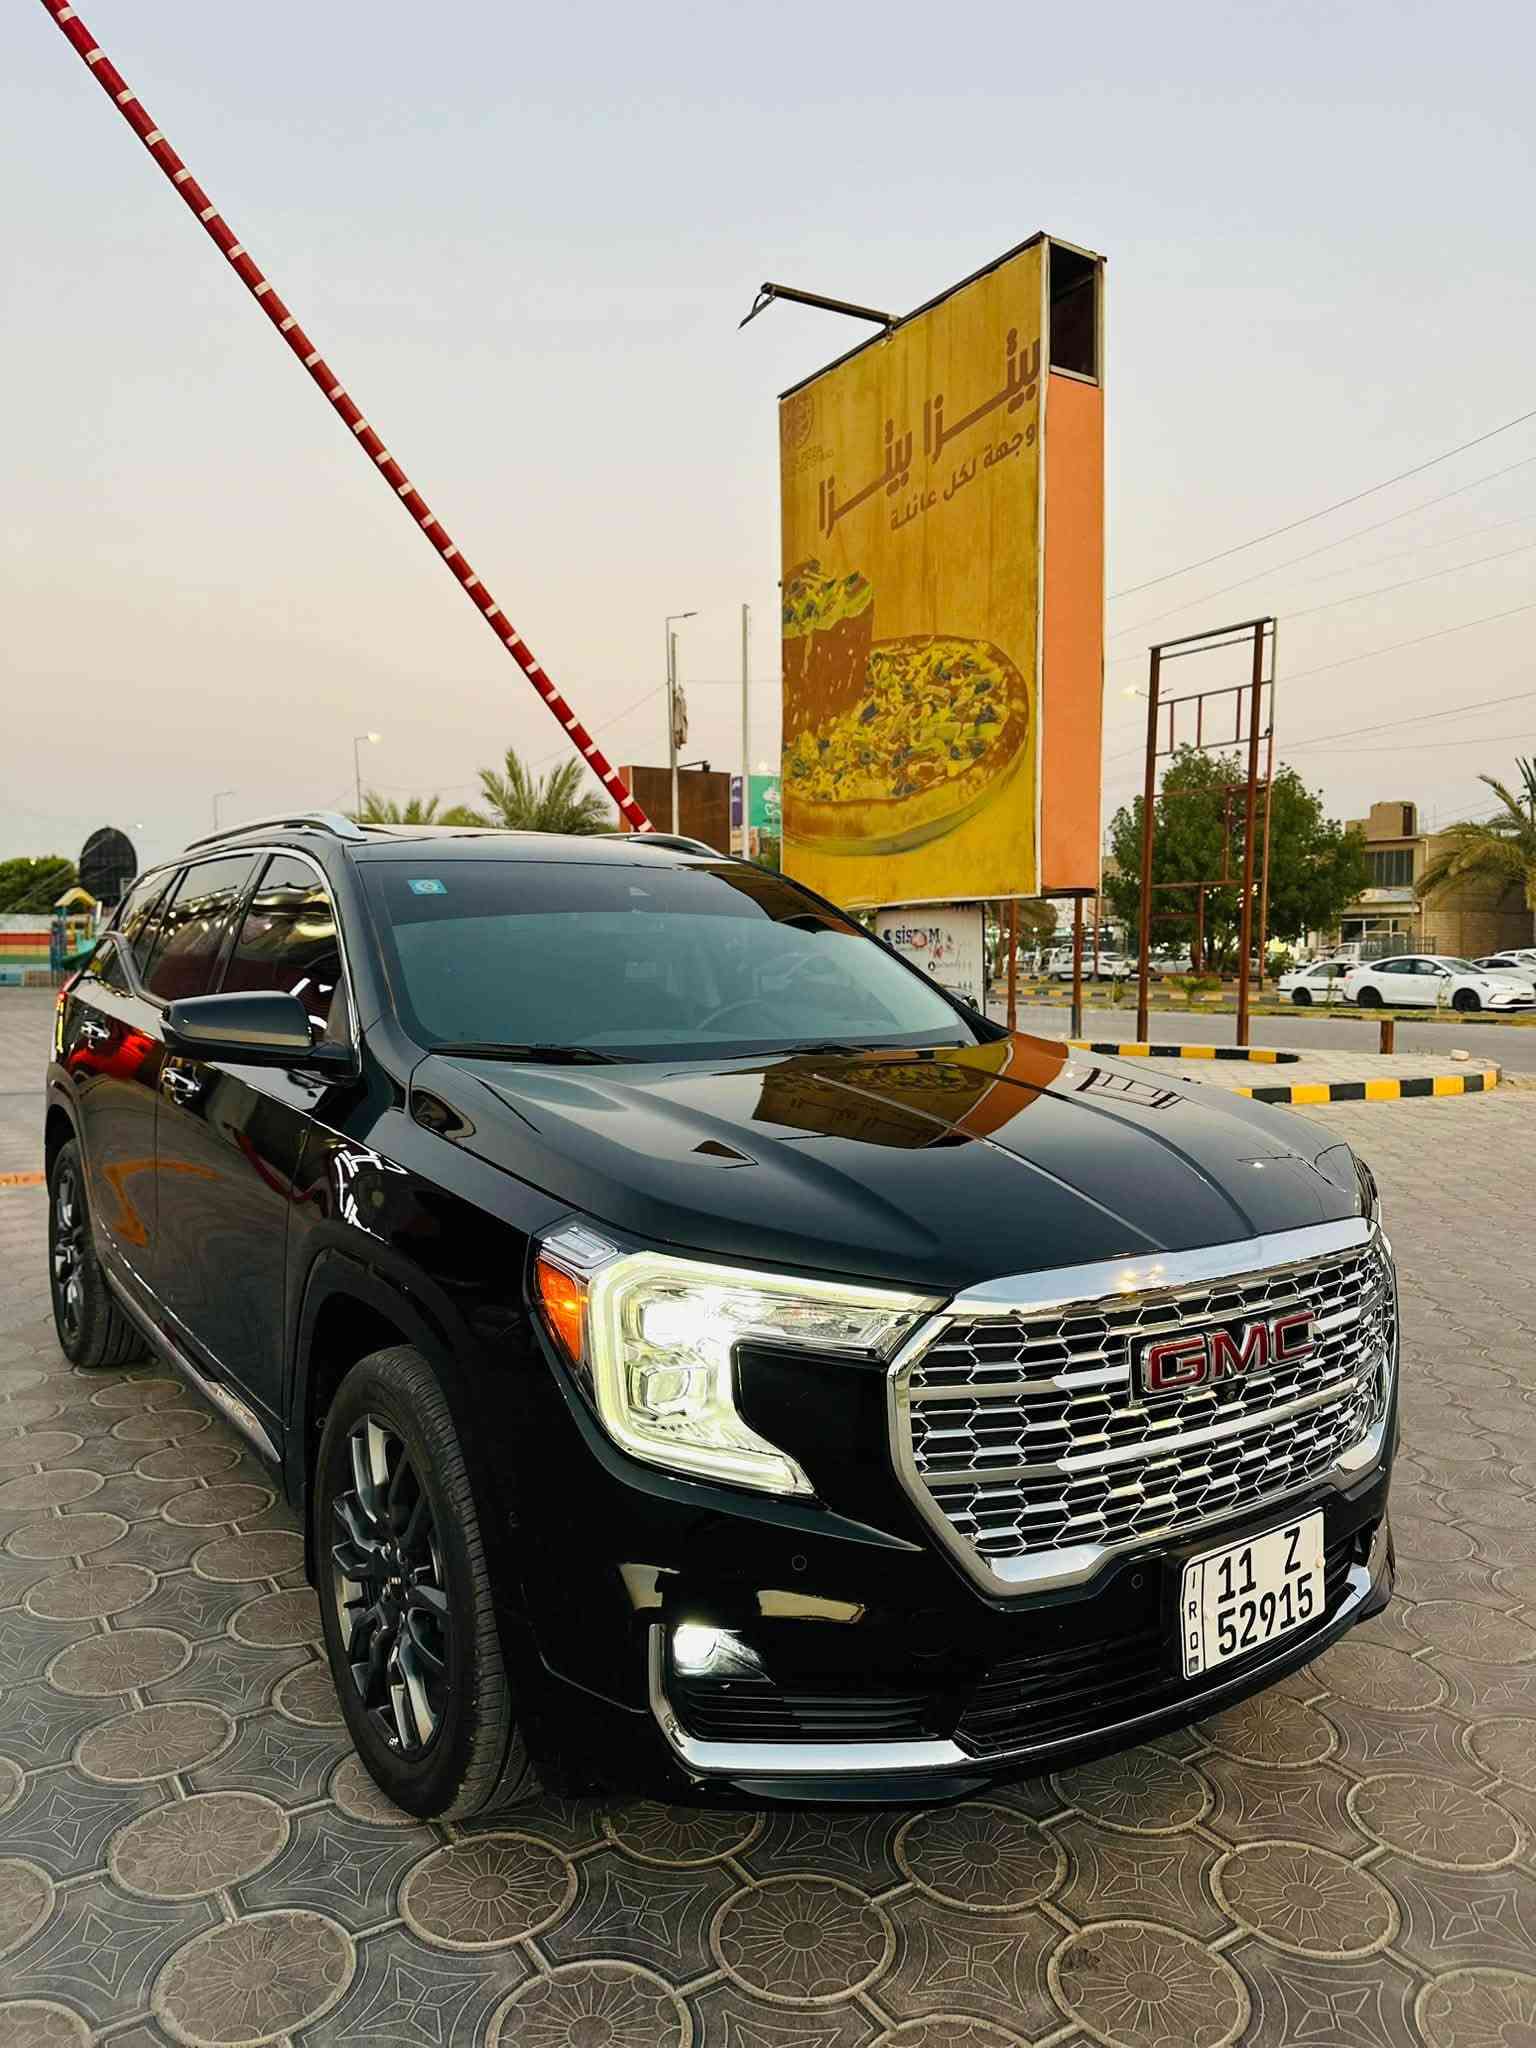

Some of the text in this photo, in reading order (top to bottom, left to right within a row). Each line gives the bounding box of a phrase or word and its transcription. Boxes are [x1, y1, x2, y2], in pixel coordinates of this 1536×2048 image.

[943, 457, 977, 501] لكل
[983, 423, 1036, 468] وجهة
[1141, 1311, 1315, 1393] GMC
[1217, 1526, 1301, 1604] 11 Z
[1217, 1572, 1313, 1656] 52915
